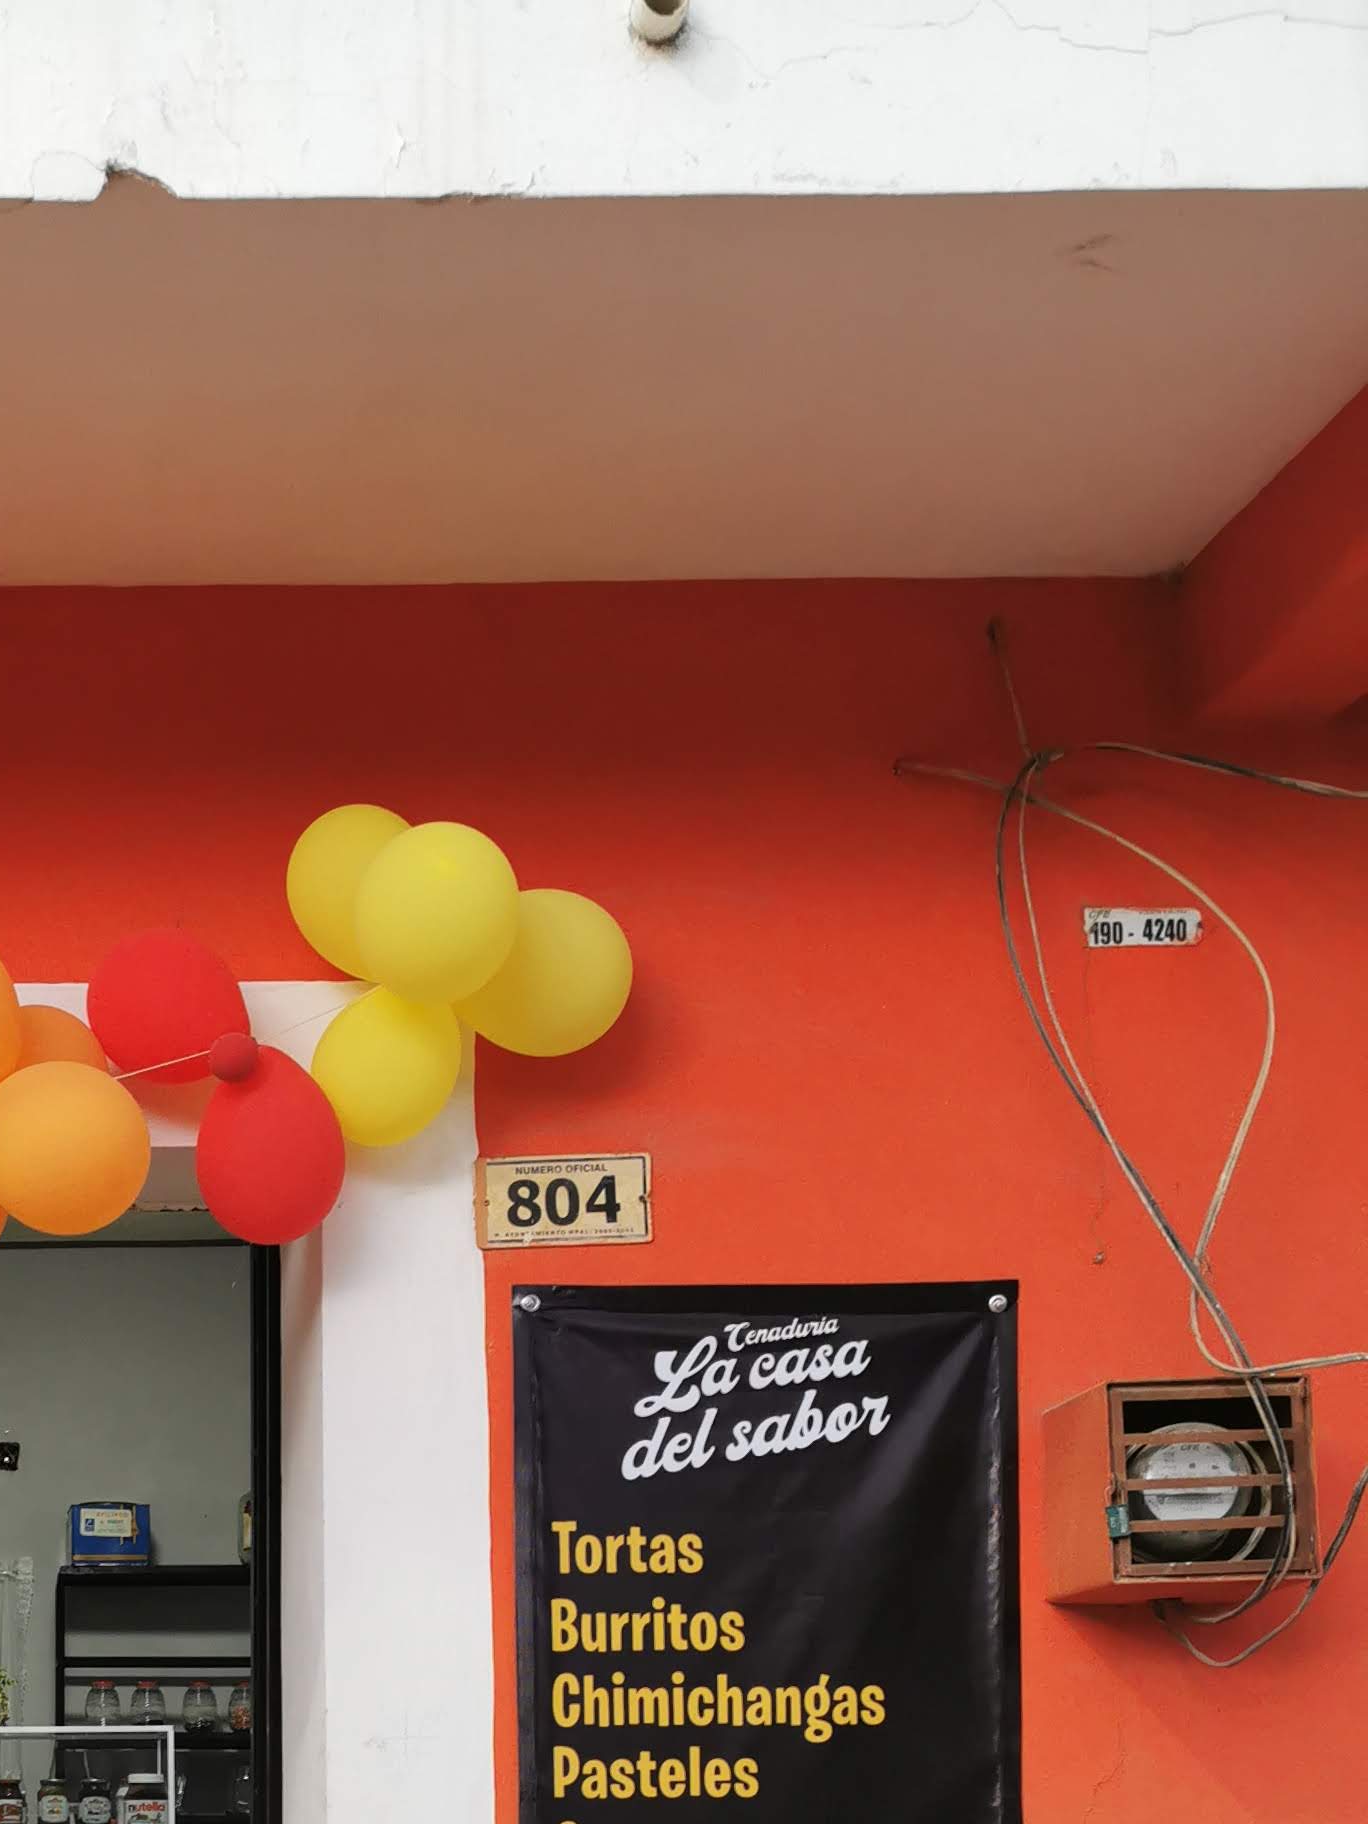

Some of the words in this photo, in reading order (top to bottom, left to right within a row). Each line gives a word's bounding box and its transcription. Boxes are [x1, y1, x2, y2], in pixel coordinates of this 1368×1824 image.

[1090, 921, 1123, 945] 190
[1142, 919, 1187, 942] 4240
[514, 1165, 563, 1176] NUMERO
[565, 1163, 609, 1173] OFICIAL
[507, 1175, 621, 1228] 804
[633, 1335, 741, 1418] La
[748, 1339, 872, 1390] casa
[620, 1407, 716, 1480] del
[724, 1388, 891, 1463] sabor
[551, 1520, 704, 1575] Tortas
[550, 1596, 746, 1653] Burritos
[552, 1670, 886, 1744] Chimichangas
[552, 1745, 760, 1800] Pasteles
[128, 1801, 165, 1812] nutella
